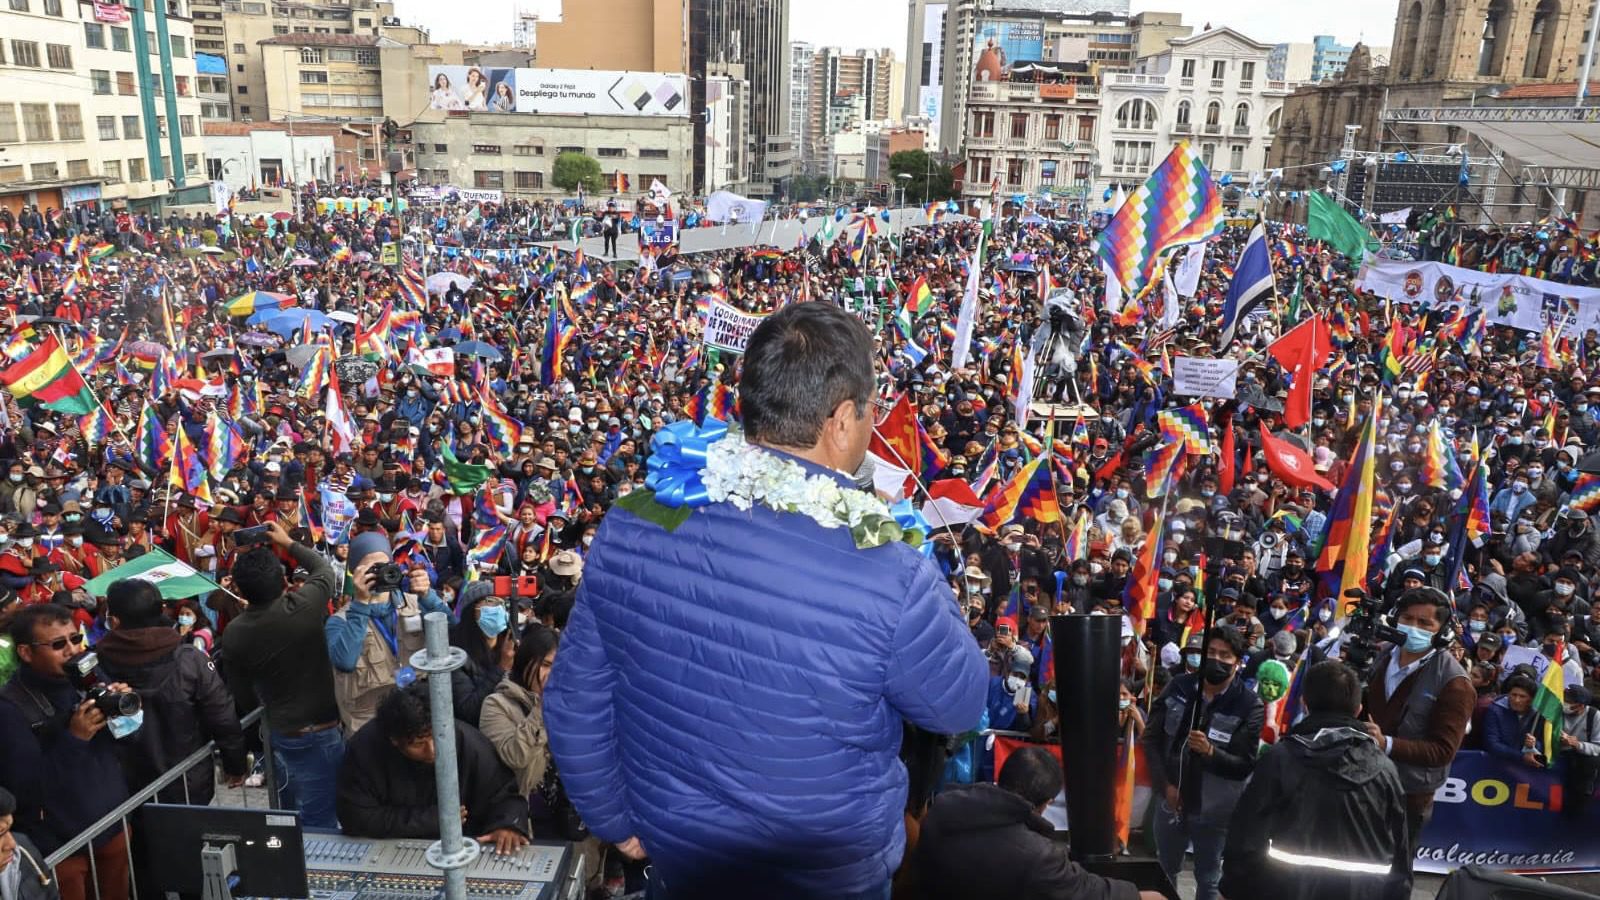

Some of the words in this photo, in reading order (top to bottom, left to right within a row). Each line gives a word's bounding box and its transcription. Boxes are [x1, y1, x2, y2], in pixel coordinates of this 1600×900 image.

[519, 89, 558, 99] Despliega
[559, 90, 568, 98] tu
[568, 90, 596, 99] mundo
[714, 306, 762, 327] COORDINADO
[708, 317, 717, 329] DE
[717, 319, 753, 338] PROFESIO
[714, 331, 739, 349] SANTA
[1432, 777, 1564, 812] BOLI
[1416, 842, 1576, 865] volucionaria
